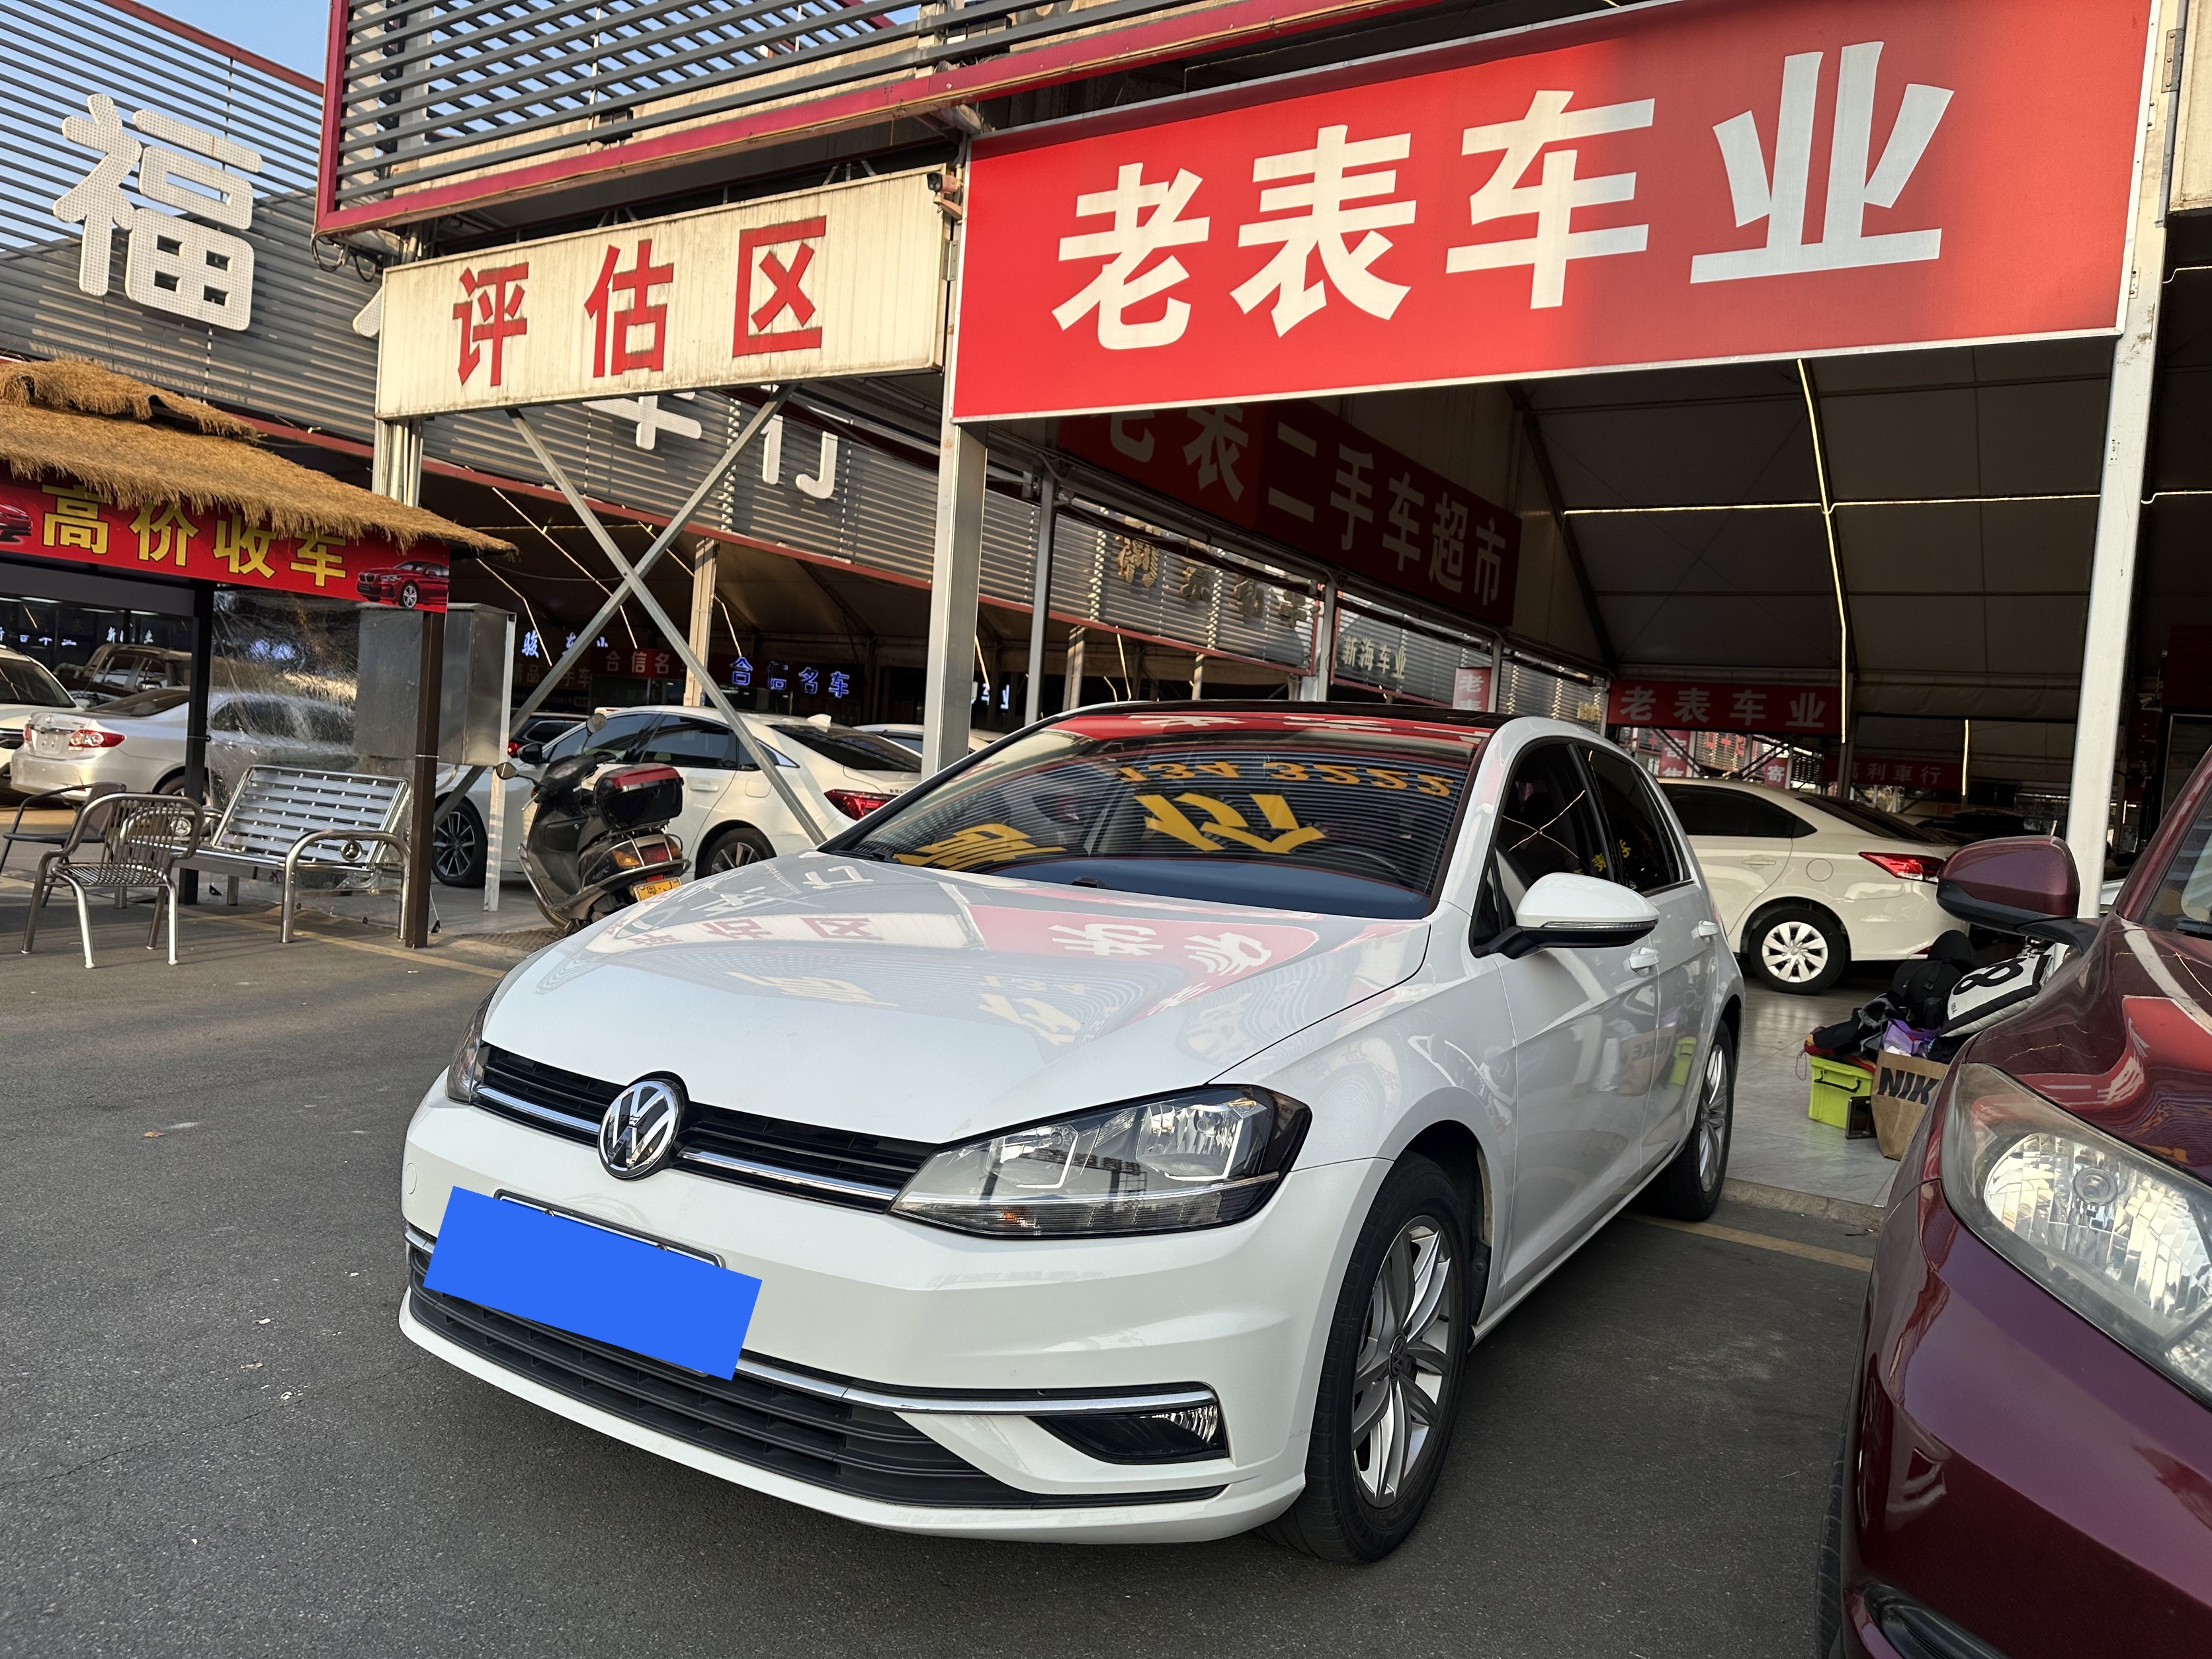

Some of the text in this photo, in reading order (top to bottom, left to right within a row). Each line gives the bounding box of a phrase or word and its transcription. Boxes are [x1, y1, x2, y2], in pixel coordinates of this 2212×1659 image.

[52, 93, 263, 331] 福
[1052, 40, 1955, 351] 老表车业
[452, 215, 827, 386] 评估区
[41, 484, 347, 587] 高价收车
[605, 650, 687, 675] 合信名
[1341, 634, 1408, 679] 新海车业
[1619, 686, 1826, 728] 老表车业
[599, 1080, 679, 1177] VW
